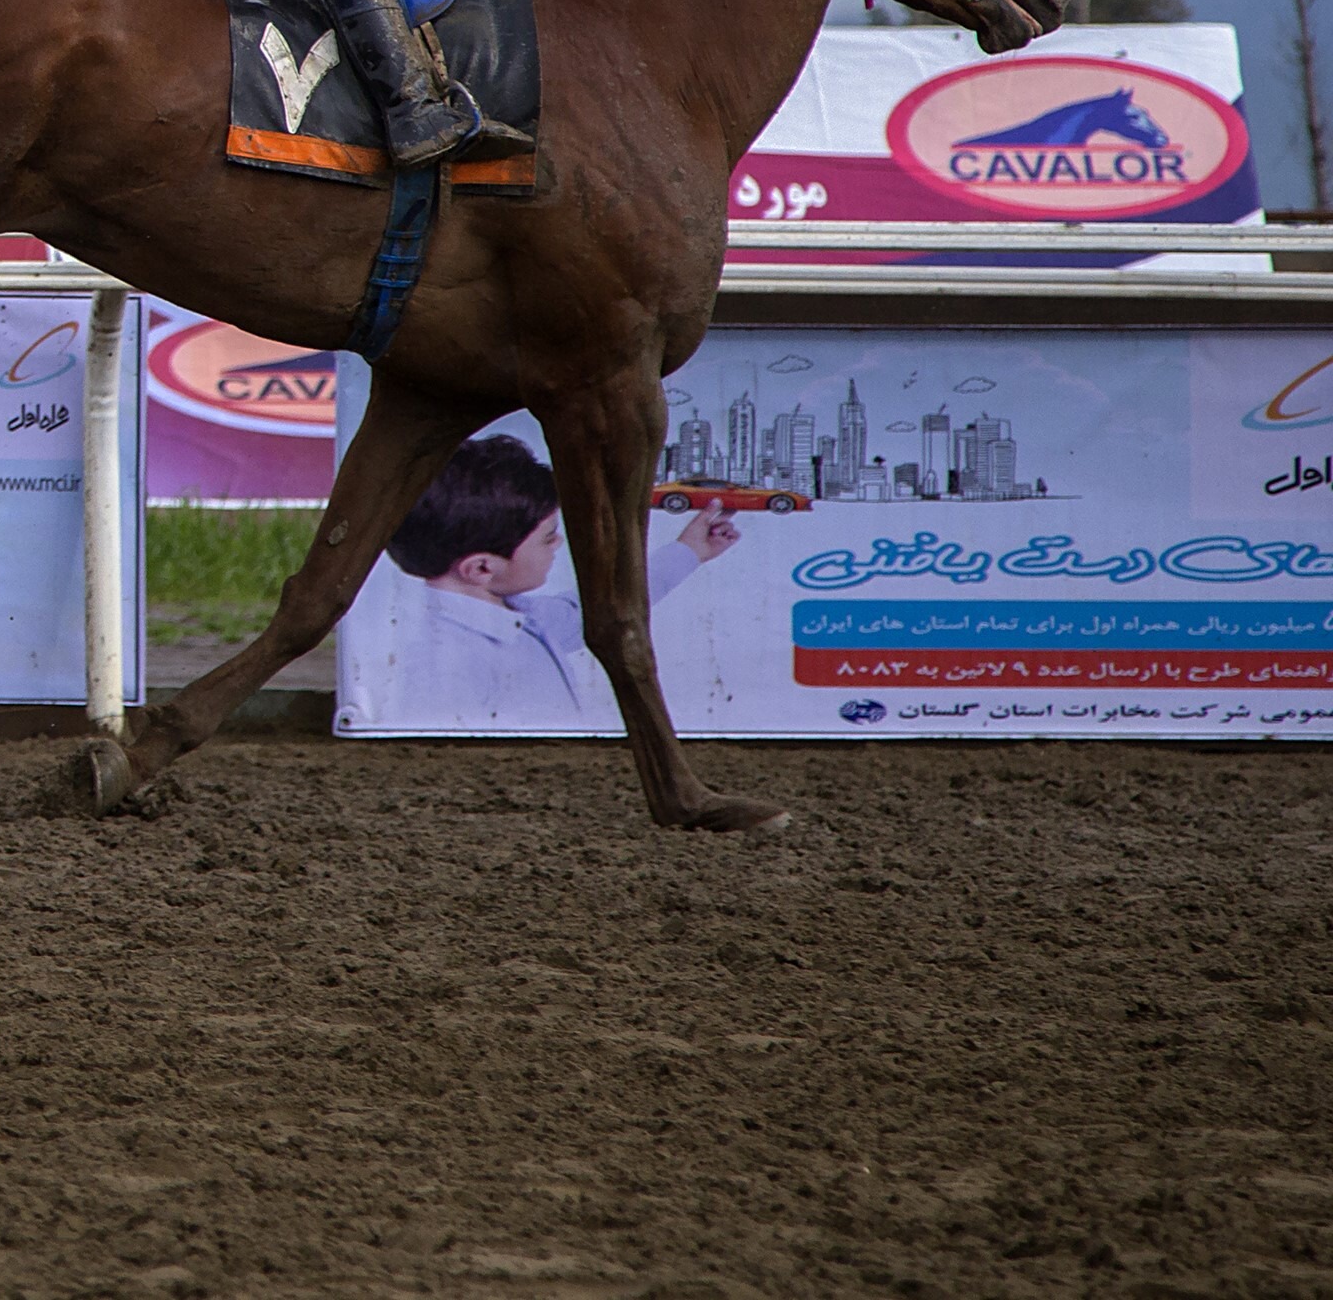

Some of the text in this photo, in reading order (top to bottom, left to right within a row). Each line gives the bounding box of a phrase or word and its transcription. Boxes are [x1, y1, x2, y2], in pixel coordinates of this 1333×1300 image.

[949, 152, 1188, 183] CAVALOR
[736, 173, 828, 220] مورد
[217, 375, 335, 401] CAV
[802, 615, 853, 635] ایران
[859, 615, 905, 634] های
[911, 615, 970, 635] استان
[976, 615, 1020, 634] تمام
[1026, 615, 1074, 636] برای
[1080, 615, 1117, 636] اول
[1123, 616, 1181, 636] همراه
[1187, 616, 1241, 637] ریالی
[1246, 616, 1316, 637] میلیون
[836, 661, 910, 677] ۸۰۸۳
[916, 663, 939, 679] به
[944, 661, 1007, 682] لاتین
[1012, 661, 1030, 677] ۹
[1038, 664, 1082, 678] عدد
[1089, 662, 1158, 683] ارسال
[1164, 663, 1182, 681] با
[1188, 664, 1242, 683] طرح
[989, 703, 1053, 720] استان
[1061, 703, 1162, 724] مخابرات
